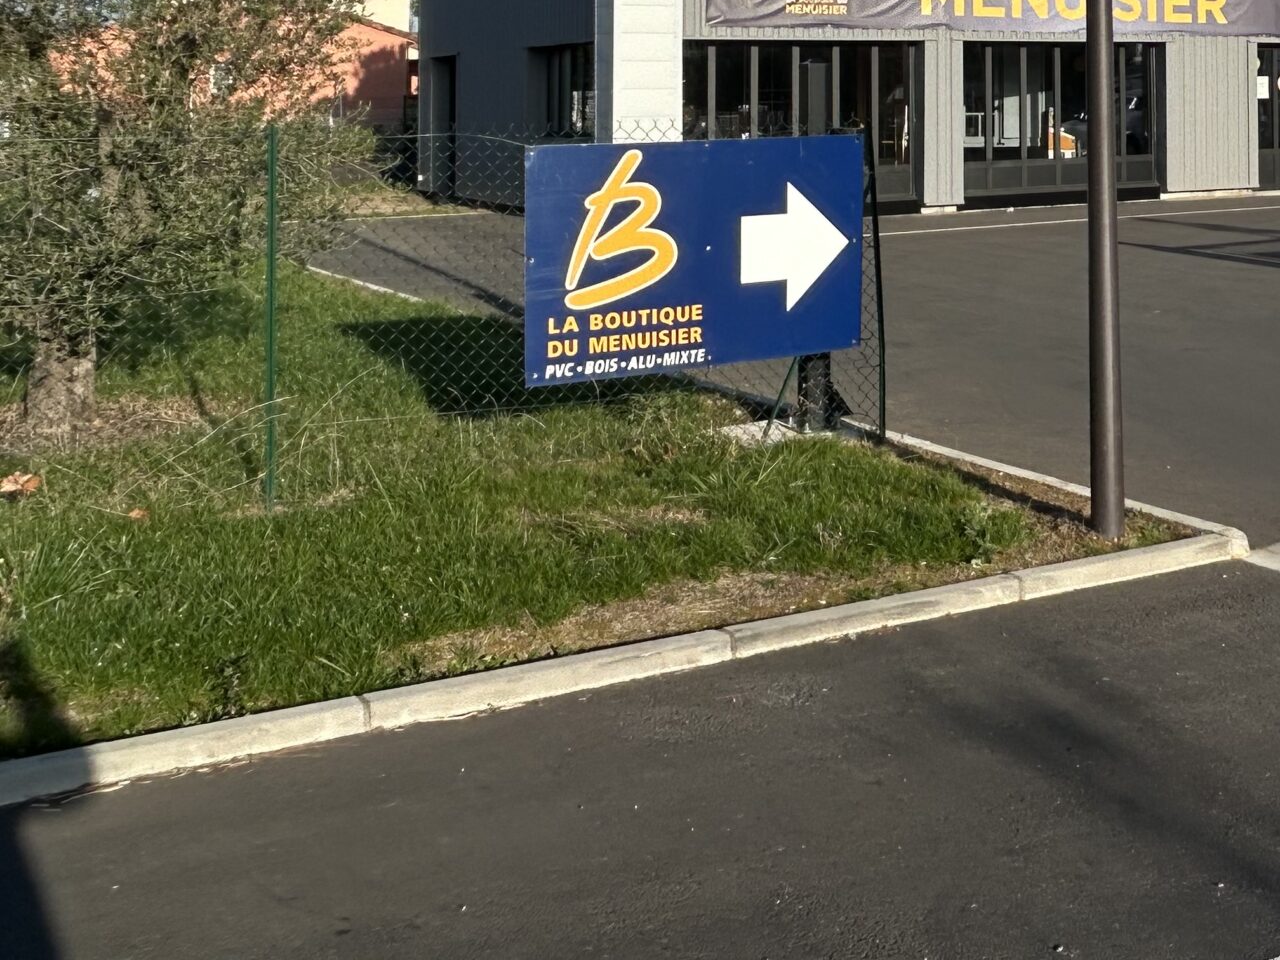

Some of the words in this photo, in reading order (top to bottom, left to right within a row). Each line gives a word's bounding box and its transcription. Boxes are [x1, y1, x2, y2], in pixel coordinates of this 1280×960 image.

[785, 4, 848, 15] MENUISIER
[548, 316, 579, 335] LA
[589, 304, 703, 330] BOUTIQUE
[547, 339, 579, 358] DU
[589, 327, 703, 354] MENUISIER
